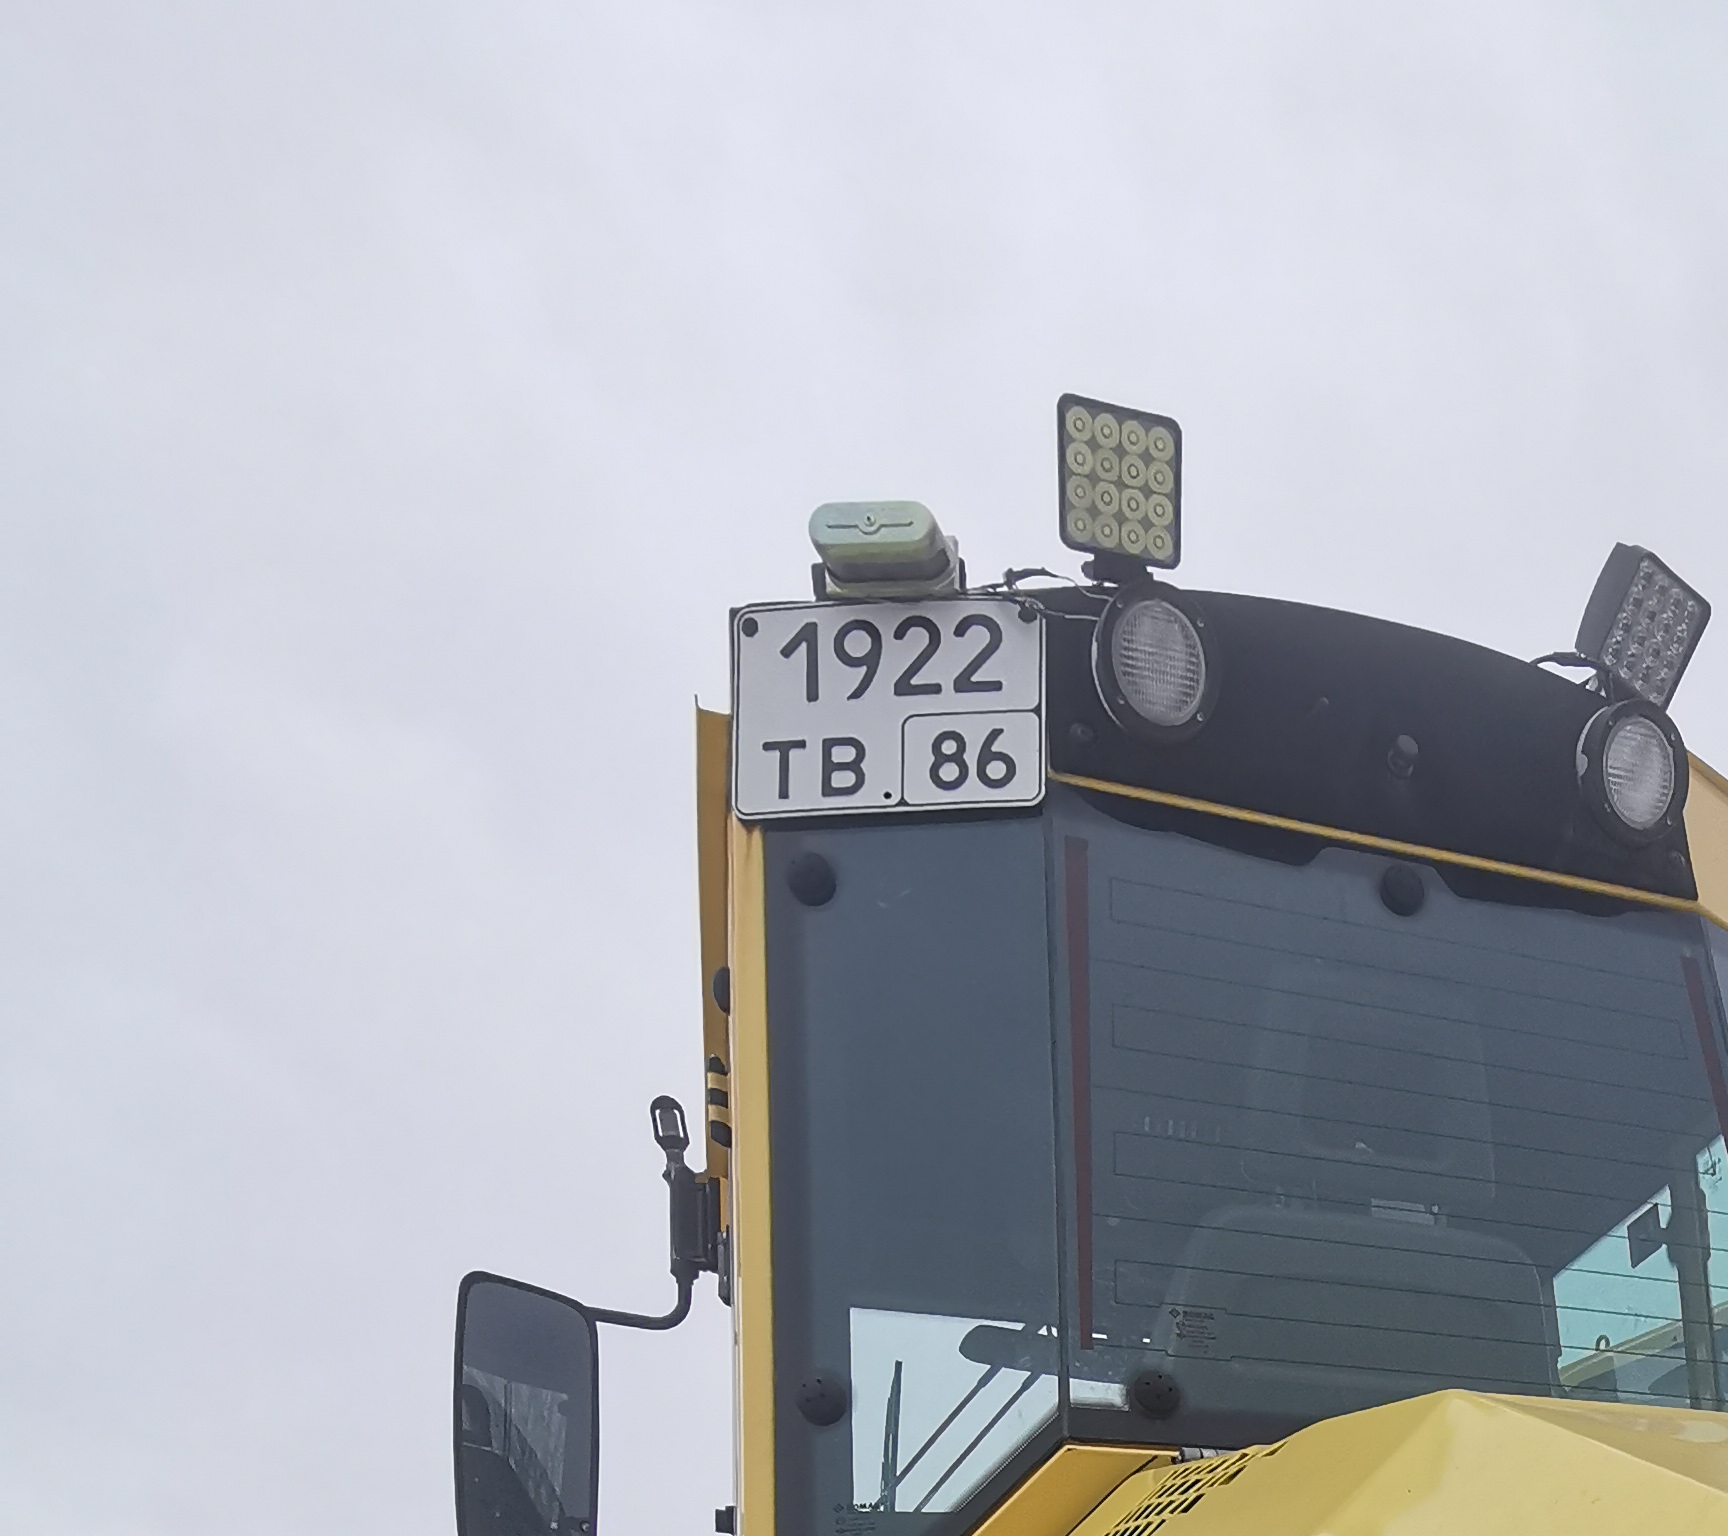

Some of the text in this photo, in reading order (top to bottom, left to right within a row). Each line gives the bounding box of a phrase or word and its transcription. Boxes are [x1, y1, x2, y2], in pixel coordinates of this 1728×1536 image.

[779, 613, 1004, 703] 1922
[762, 728, 1018, 800] ТВ 86
